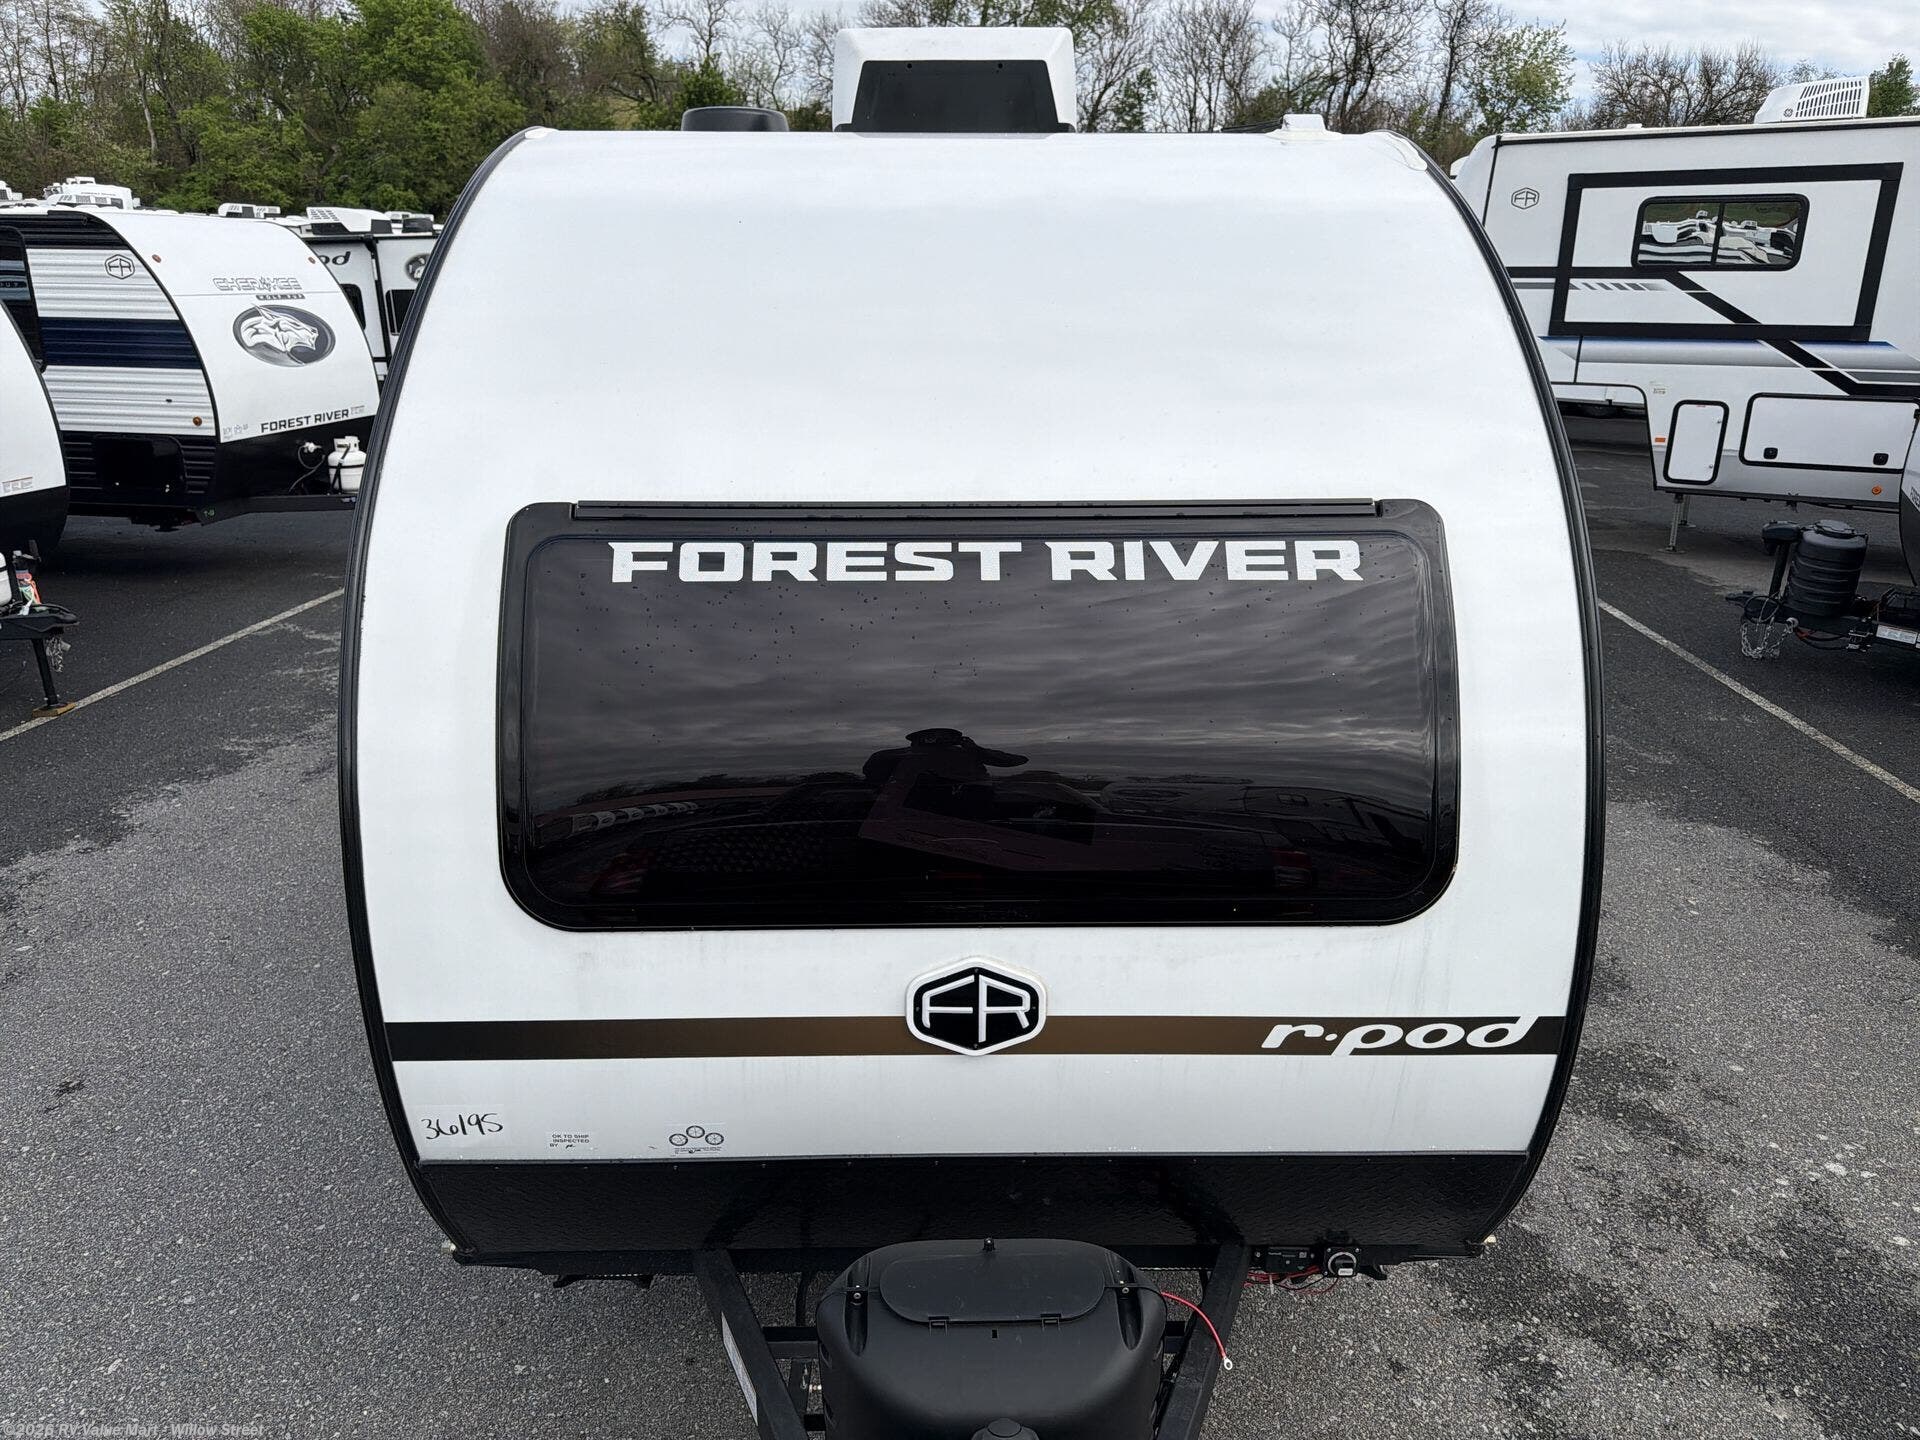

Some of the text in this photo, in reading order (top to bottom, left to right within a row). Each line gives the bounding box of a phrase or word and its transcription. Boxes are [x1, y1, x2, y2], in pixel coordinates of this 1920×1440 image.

[260, 415, 312, 433] FOREST
[313, 408, 349, 424] RIVER
[608, 539, 1363, 582] FOREST RIVER
[920, 972, 1031, 1044] FR
[420, 1112, 504, 1140] 36195
